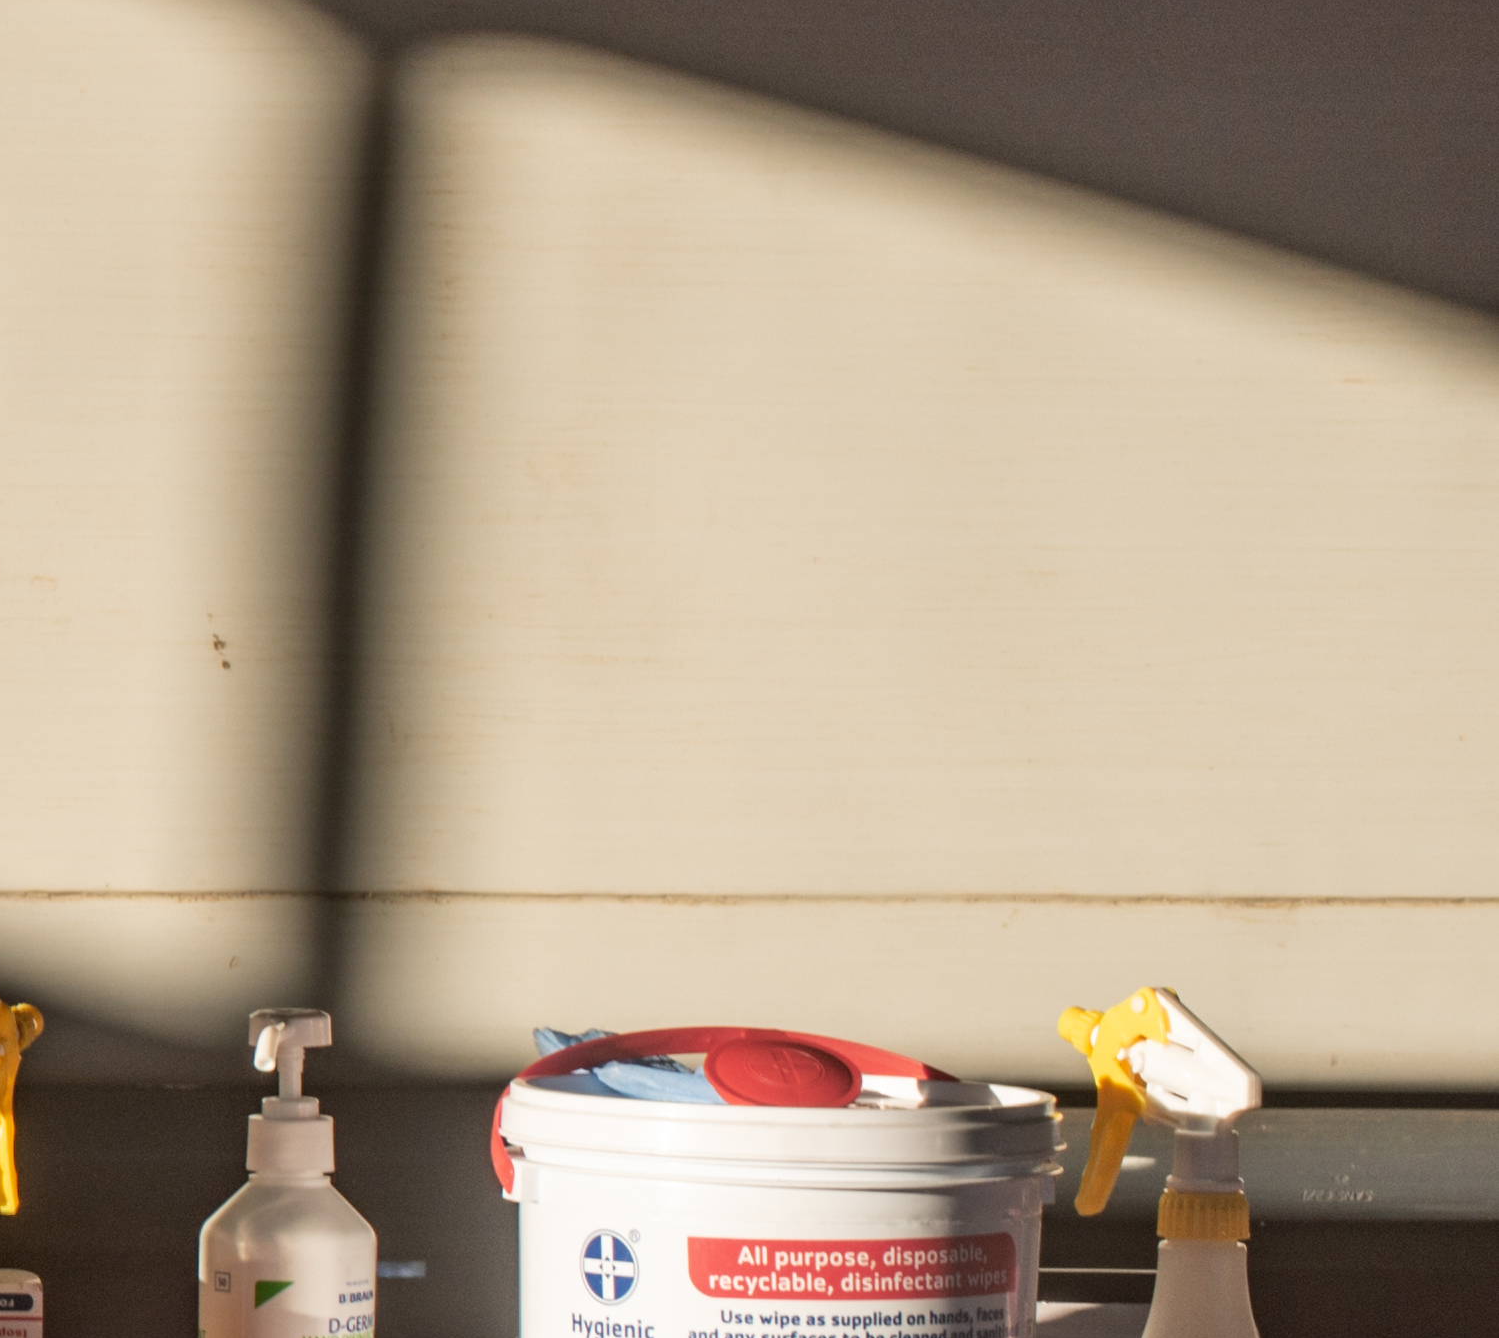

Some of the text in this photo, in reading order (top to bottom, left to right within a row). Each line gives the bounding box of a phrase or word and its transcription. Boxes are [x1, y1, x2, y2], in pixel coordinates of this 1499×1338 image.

[738, 1244, 988, 1270] All purpose, disposable,
[709, 1268, 1007, 1295] recyclable, disinfectant wipes
[721, 1307, 1004, 1330] Use wipe as supplied on hands, faces
